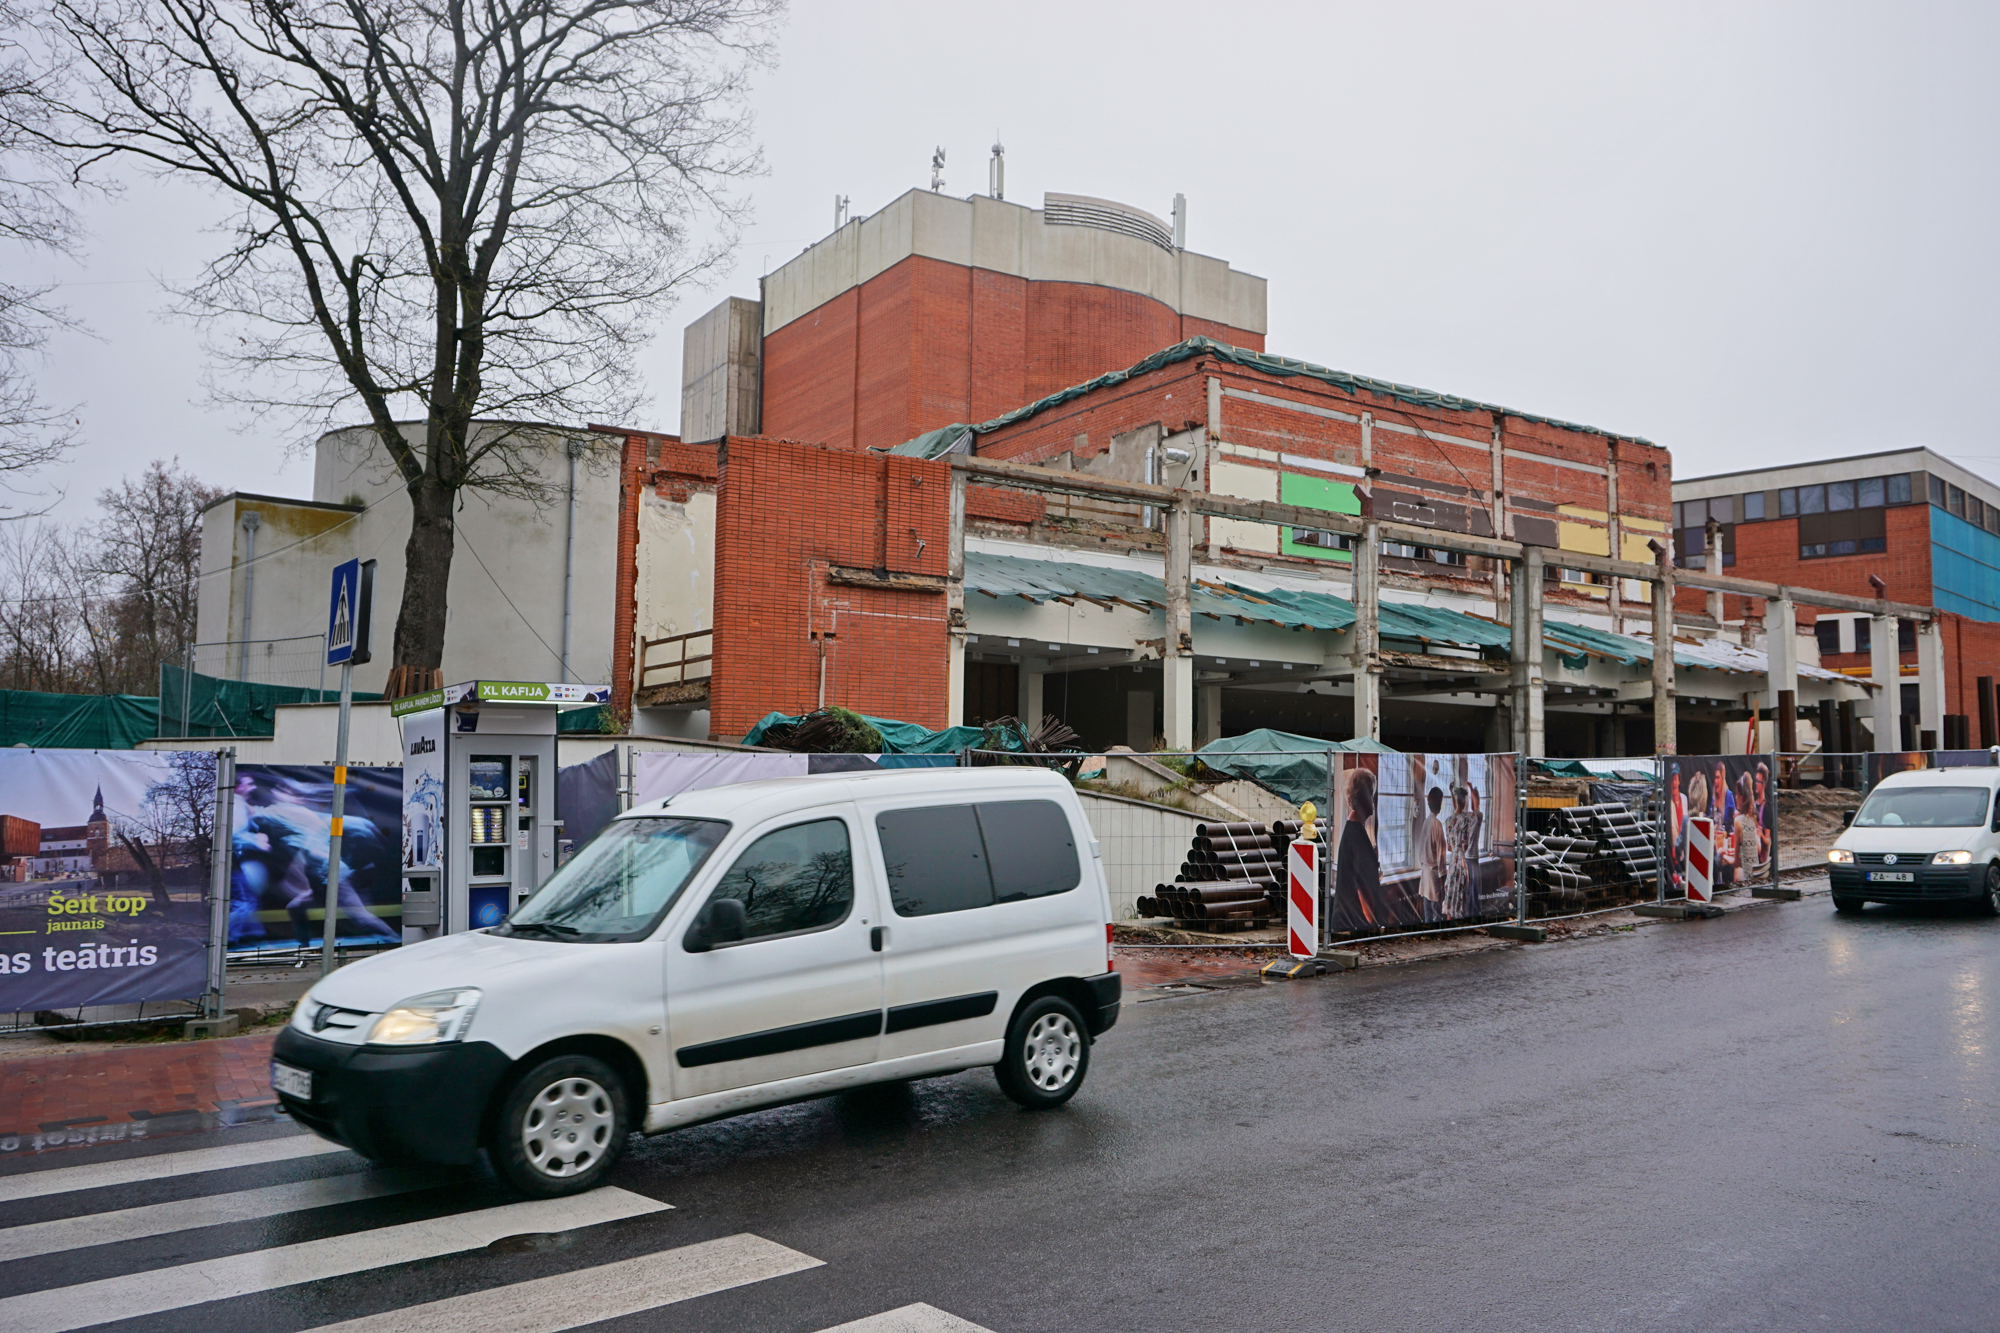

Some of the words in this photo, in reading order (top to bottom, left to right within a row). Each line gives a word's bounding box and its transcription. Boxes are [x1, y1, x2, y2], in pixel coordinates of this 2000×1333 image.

[483, 685, 499, 696] XL
[501, 685, 543, 697] KAFIJA
[394, 704, 400, 712] XL
[410, 736, 436, 755] LAVAZZA
[47, 890, 98, 915] Šeit
[105, 894, 146, 917] top
[46, 917, 105, 935] jaunais
[42, 938, 158, 972] teātris
